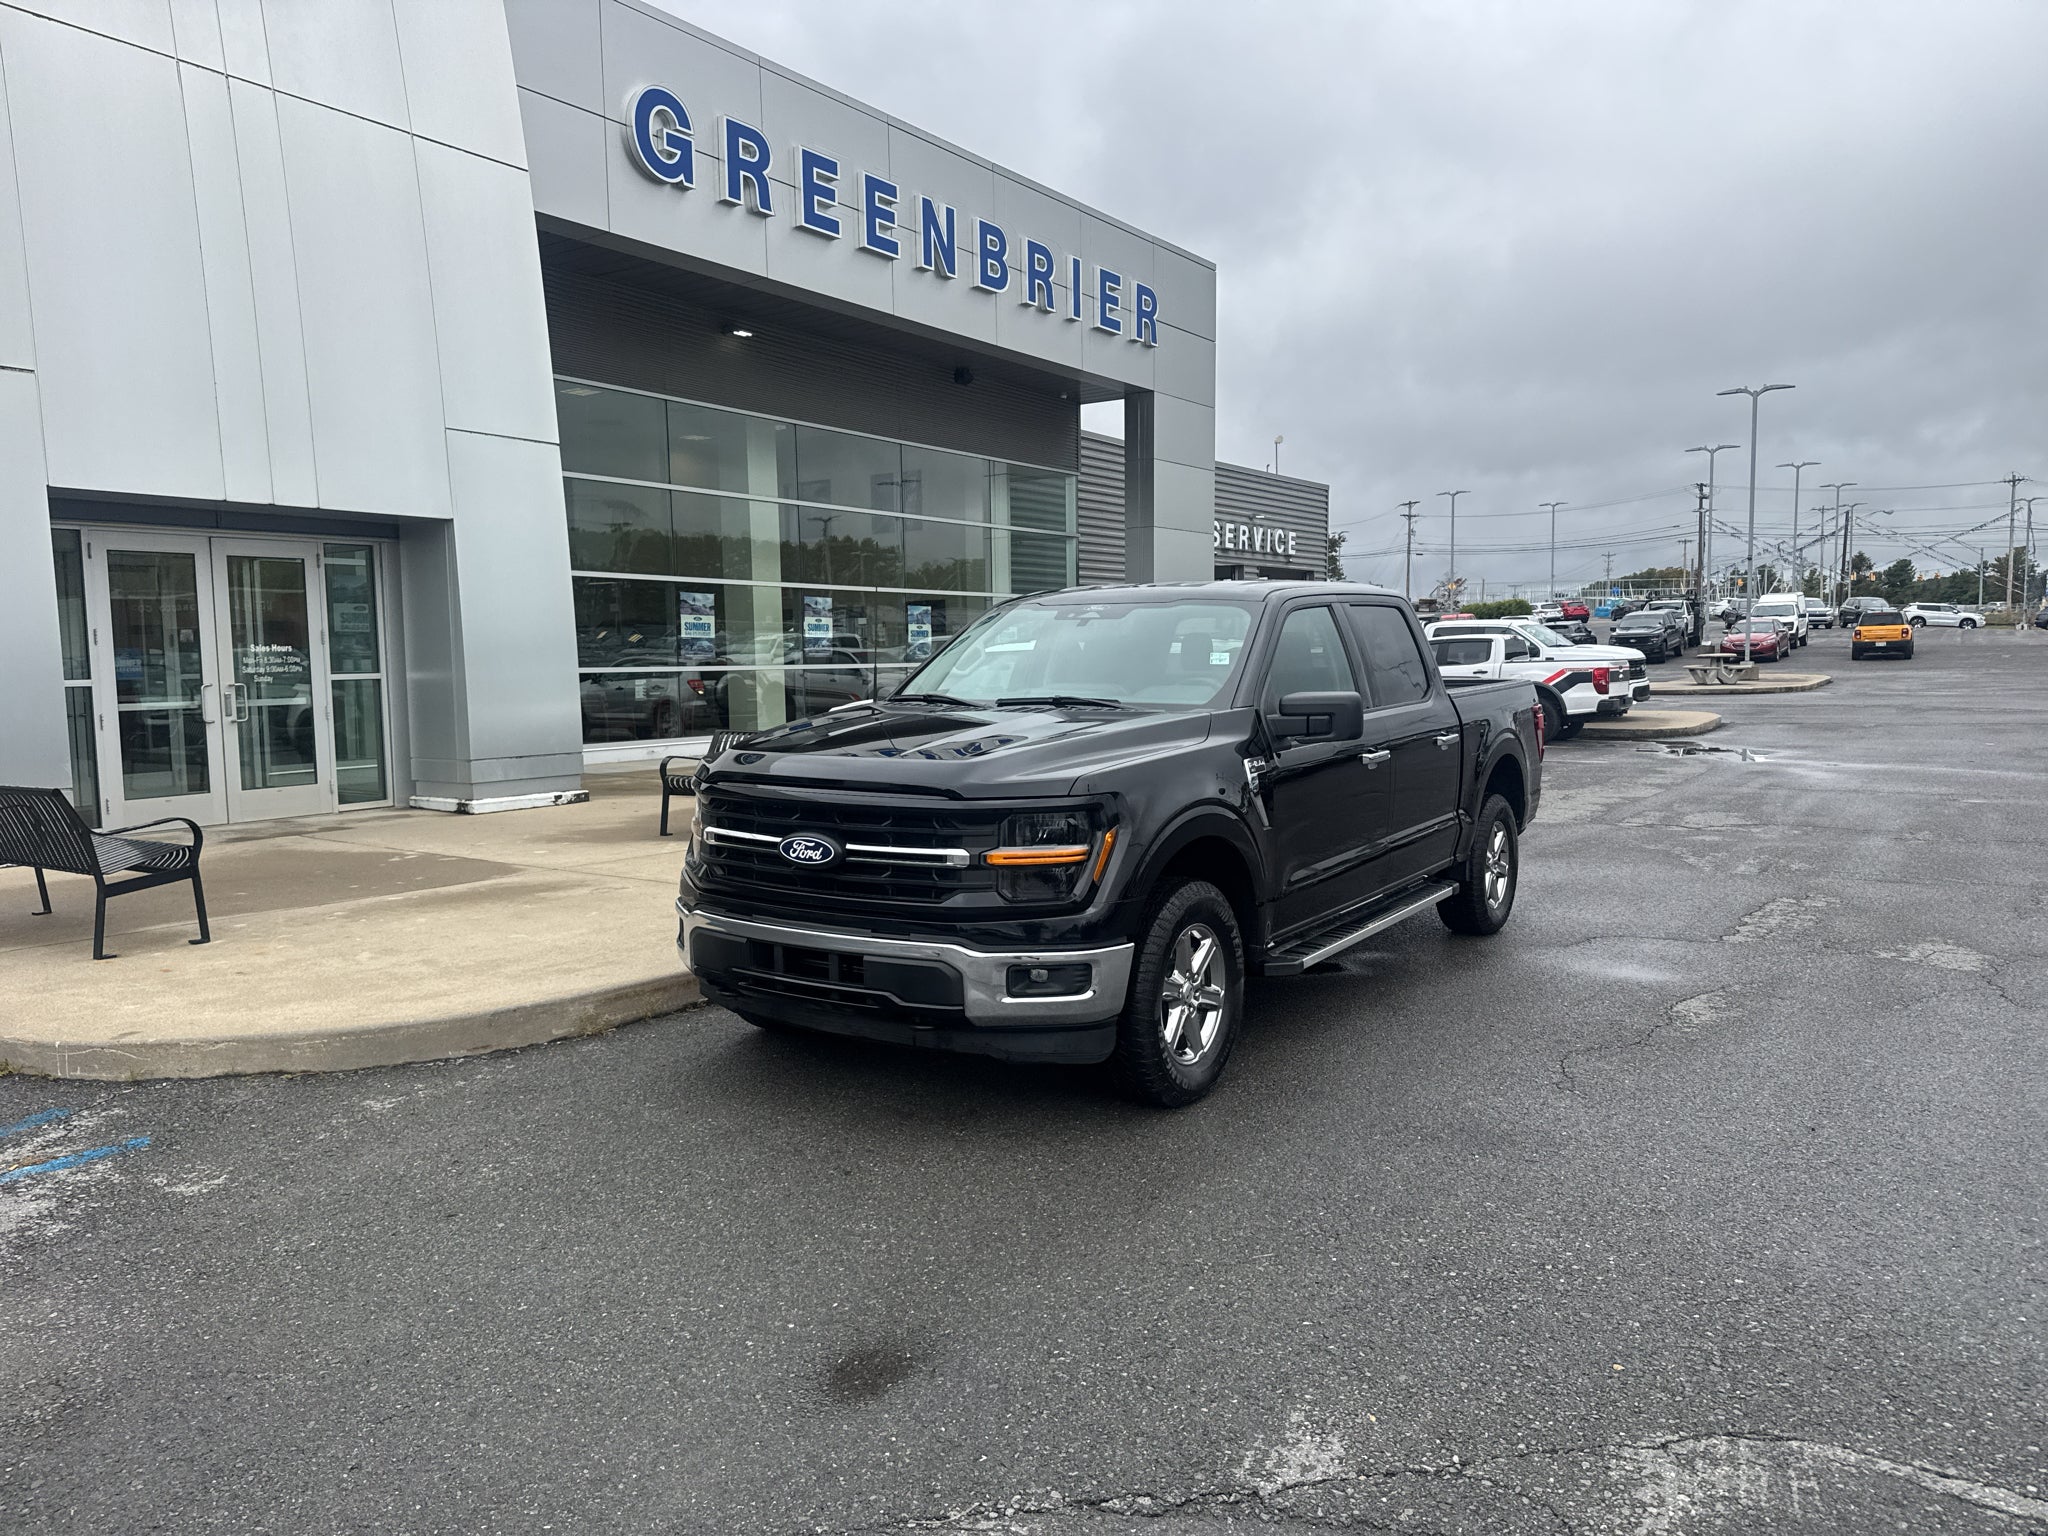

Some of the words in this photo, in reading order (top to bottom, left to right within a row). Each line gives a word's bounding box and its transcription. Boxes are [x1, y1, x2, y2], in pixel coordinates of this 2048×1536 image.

[627, 85, 1159, 347] GREENBRIER
[1213, 520, 1297, 555] SERVICE
[684, 621, 712, 631] SUMMER
[250, 644, 270, 652] Sales
[271, 644, 293, 652] Hours
[253, 675, 273, 683] Sunday
[788, 840, 825, 861] Ford
